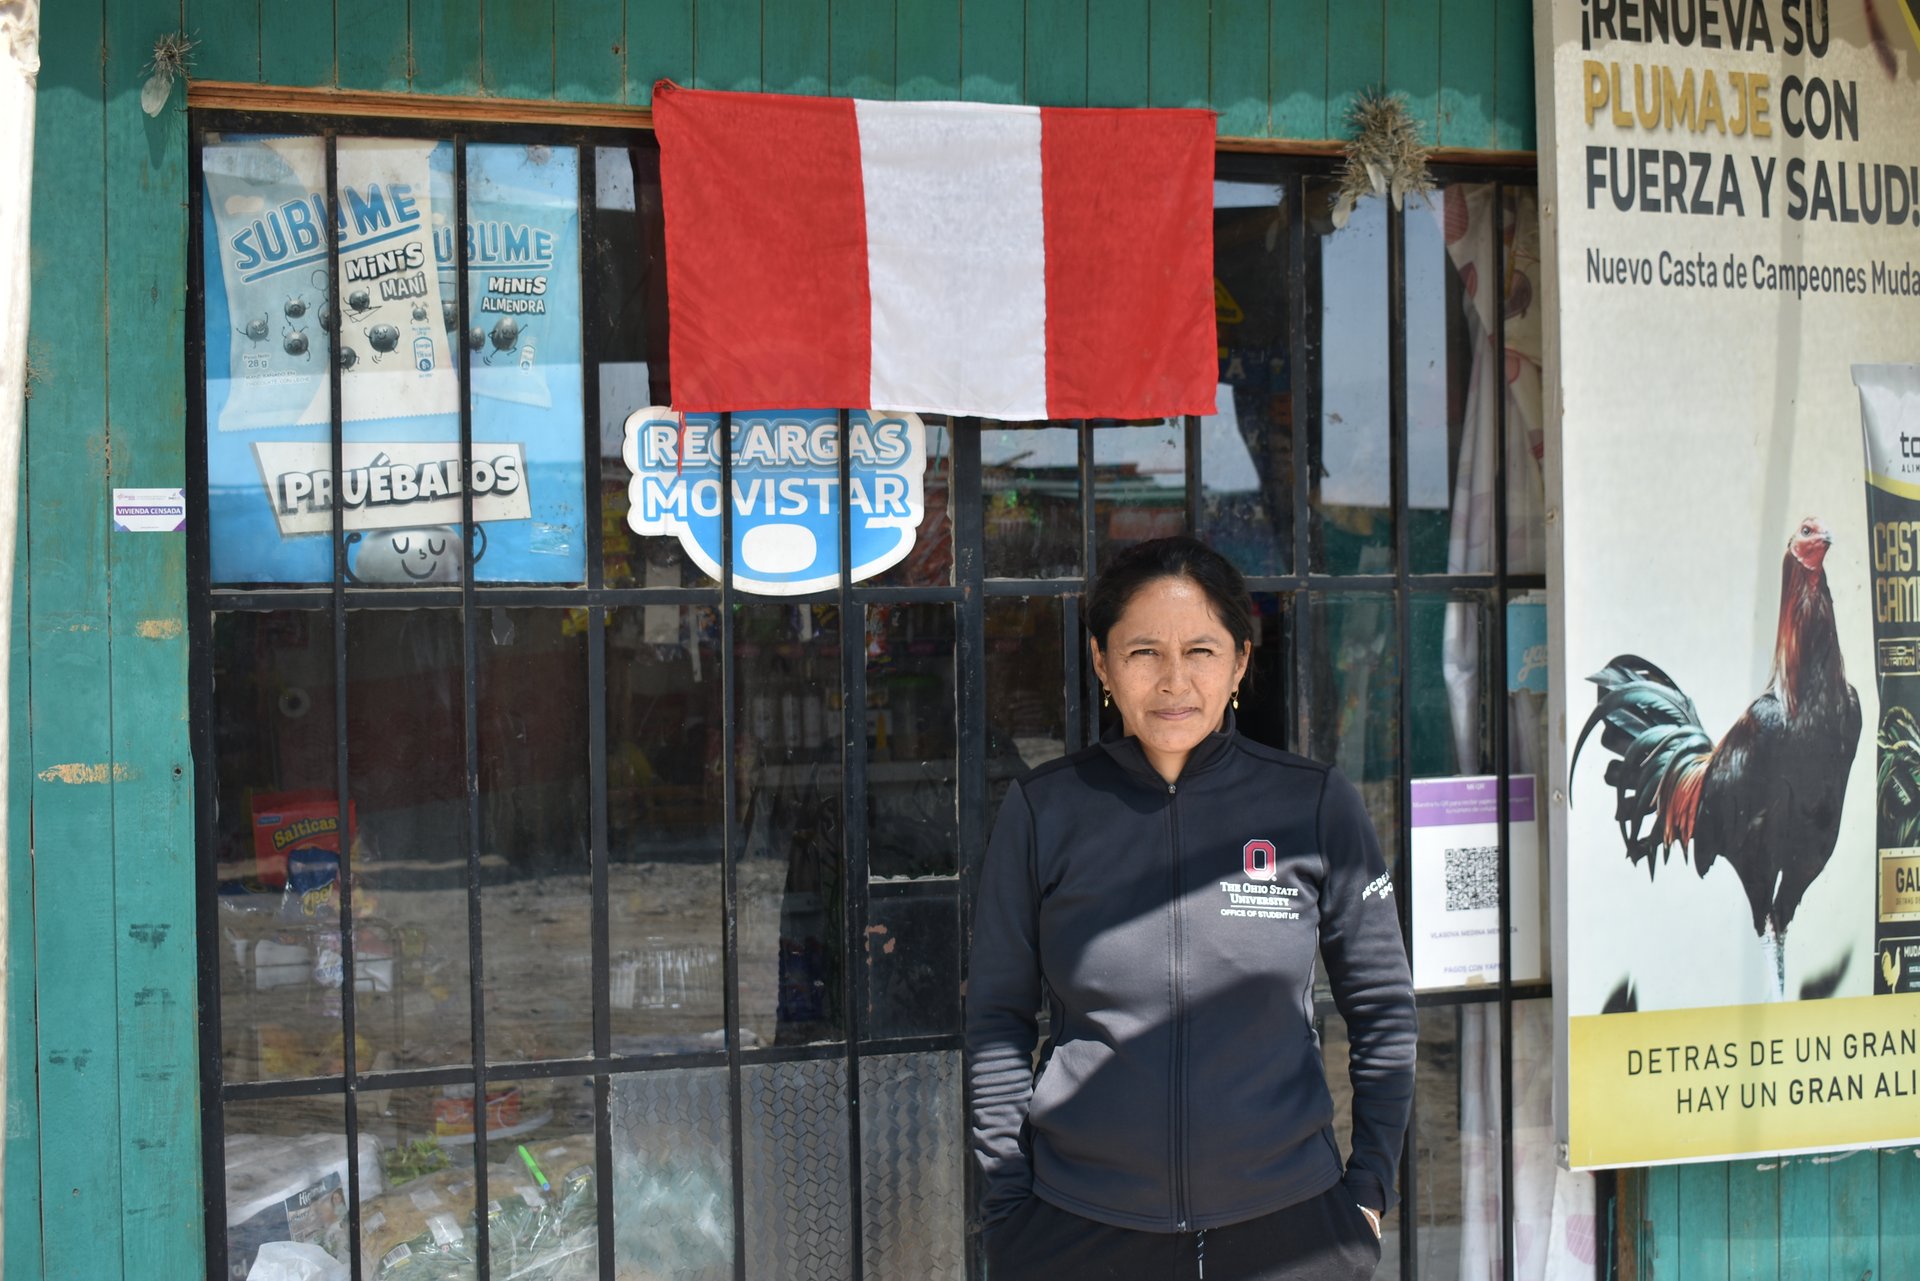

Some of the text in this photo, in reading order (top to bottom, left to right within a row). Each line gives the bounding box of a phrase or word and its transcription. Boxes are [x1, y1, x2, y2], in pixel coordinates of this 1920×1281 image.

[1781, 0, 1829, 58] SU
[1583, 60, 1859, 141] PLUMAJE CON
[1586, 146, 1920, 228] FUERZA Y SALUD!
[231, 183, 421, 270] SUBLIME
[380, 272, 427, 301] MANÍ
[1586, 248, 1652, 285] Nuevo
[1659, 251, 1717, 288] Casta
[1723, 253, 1747, 288] de
[1752, 255, 1866, 300] Campeones
[481, 297, 546, 315] ALMENDRA
[248, 360, 259, 368] 28
[647, 424, 908, 466] RECARGAS
[280, 453, 520, 511] PRUÉBALOS
[646, 477, 906, 518] MOVISTAR
[274, 818, 337, 848] Salticas
[1221, 909, 1246, 917] OFFICE
[1258, 911, 1288, 919] STUDENT
[1628, 1029, 1916, 1075] DETRAS DE UN GRAN
[1677, 1085, 1729, 1114] HAY
[1741, 1081, 1776, 1108] UN
[1789, 1073, 1863, 1105] GRAN
